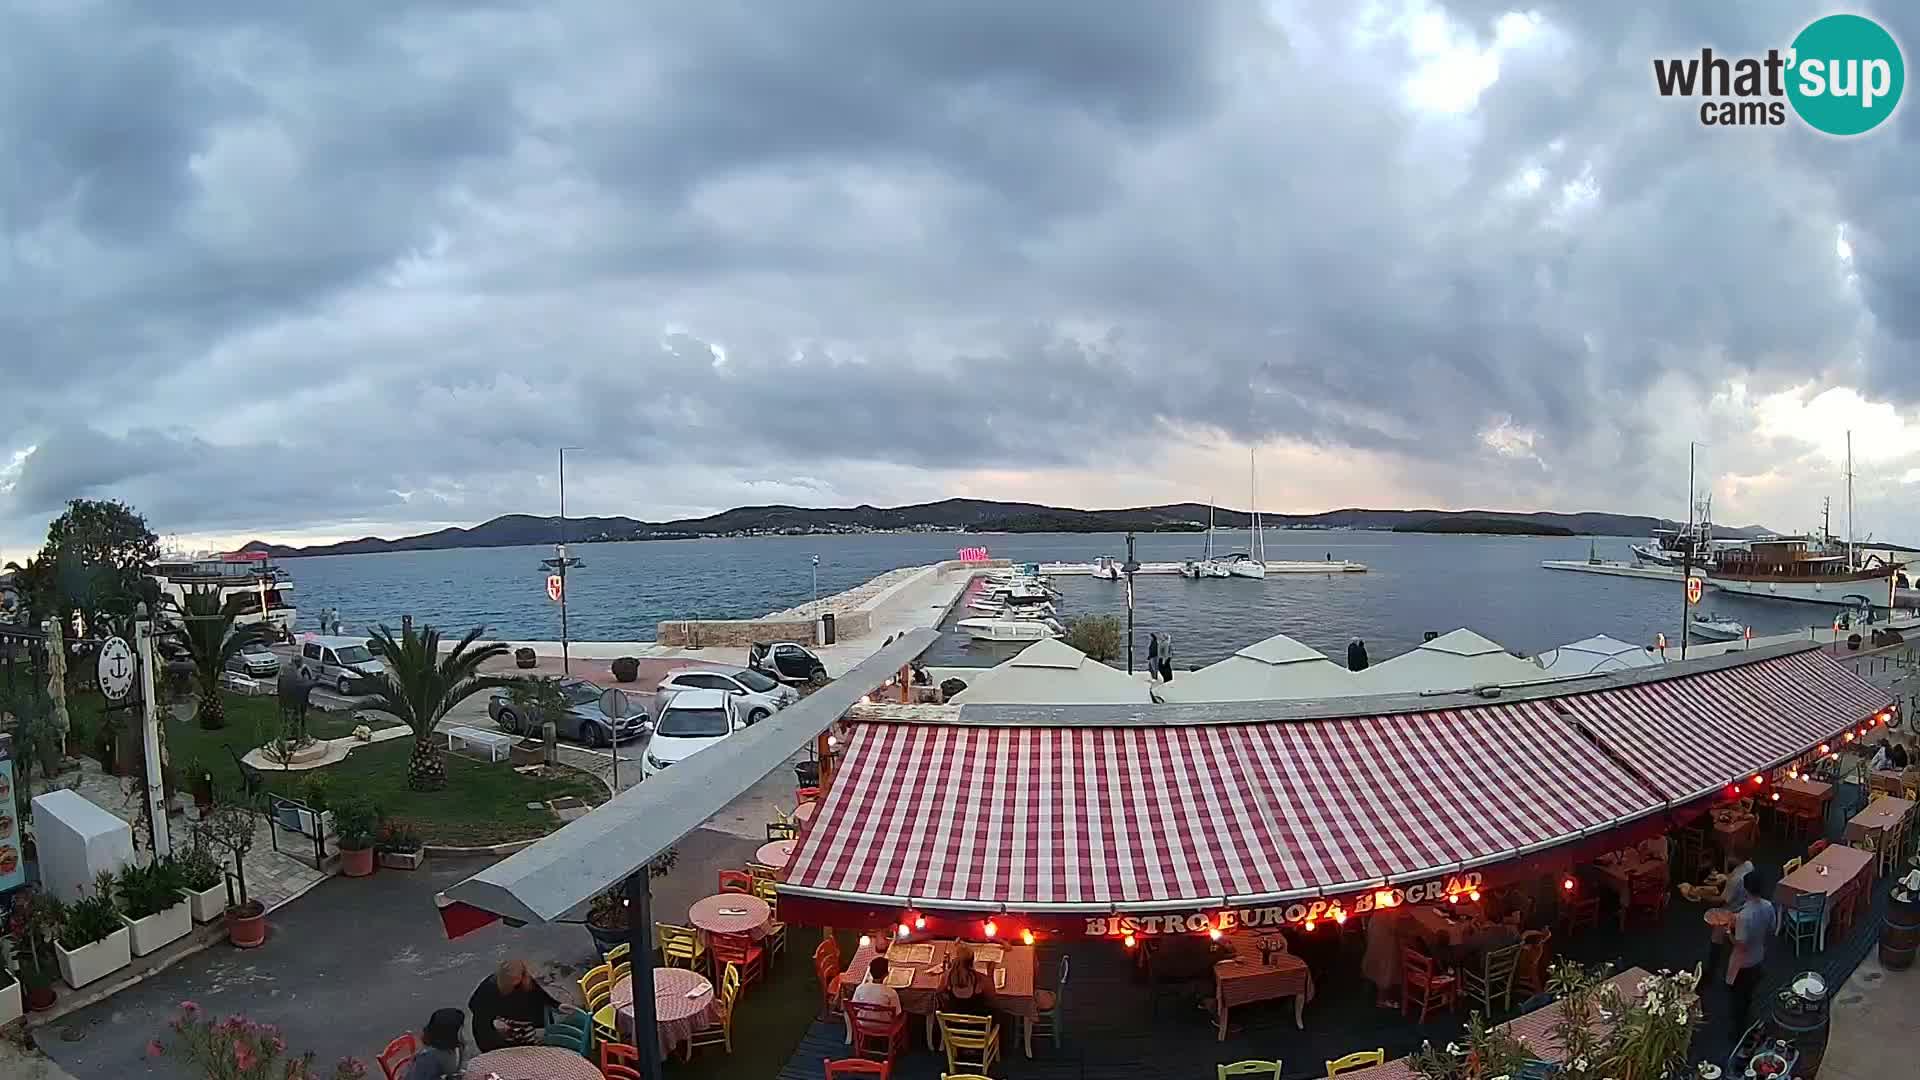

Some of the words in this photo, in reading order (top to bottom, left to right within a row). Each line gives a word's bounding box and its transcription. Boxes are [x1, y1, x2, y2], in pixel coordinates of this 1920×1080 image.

[1085, 913, 1210, 936] BISTRO
[1218, 900, 1346, 930] EUROPA
[1354, 872, 1482, 913] BIOGRAD
